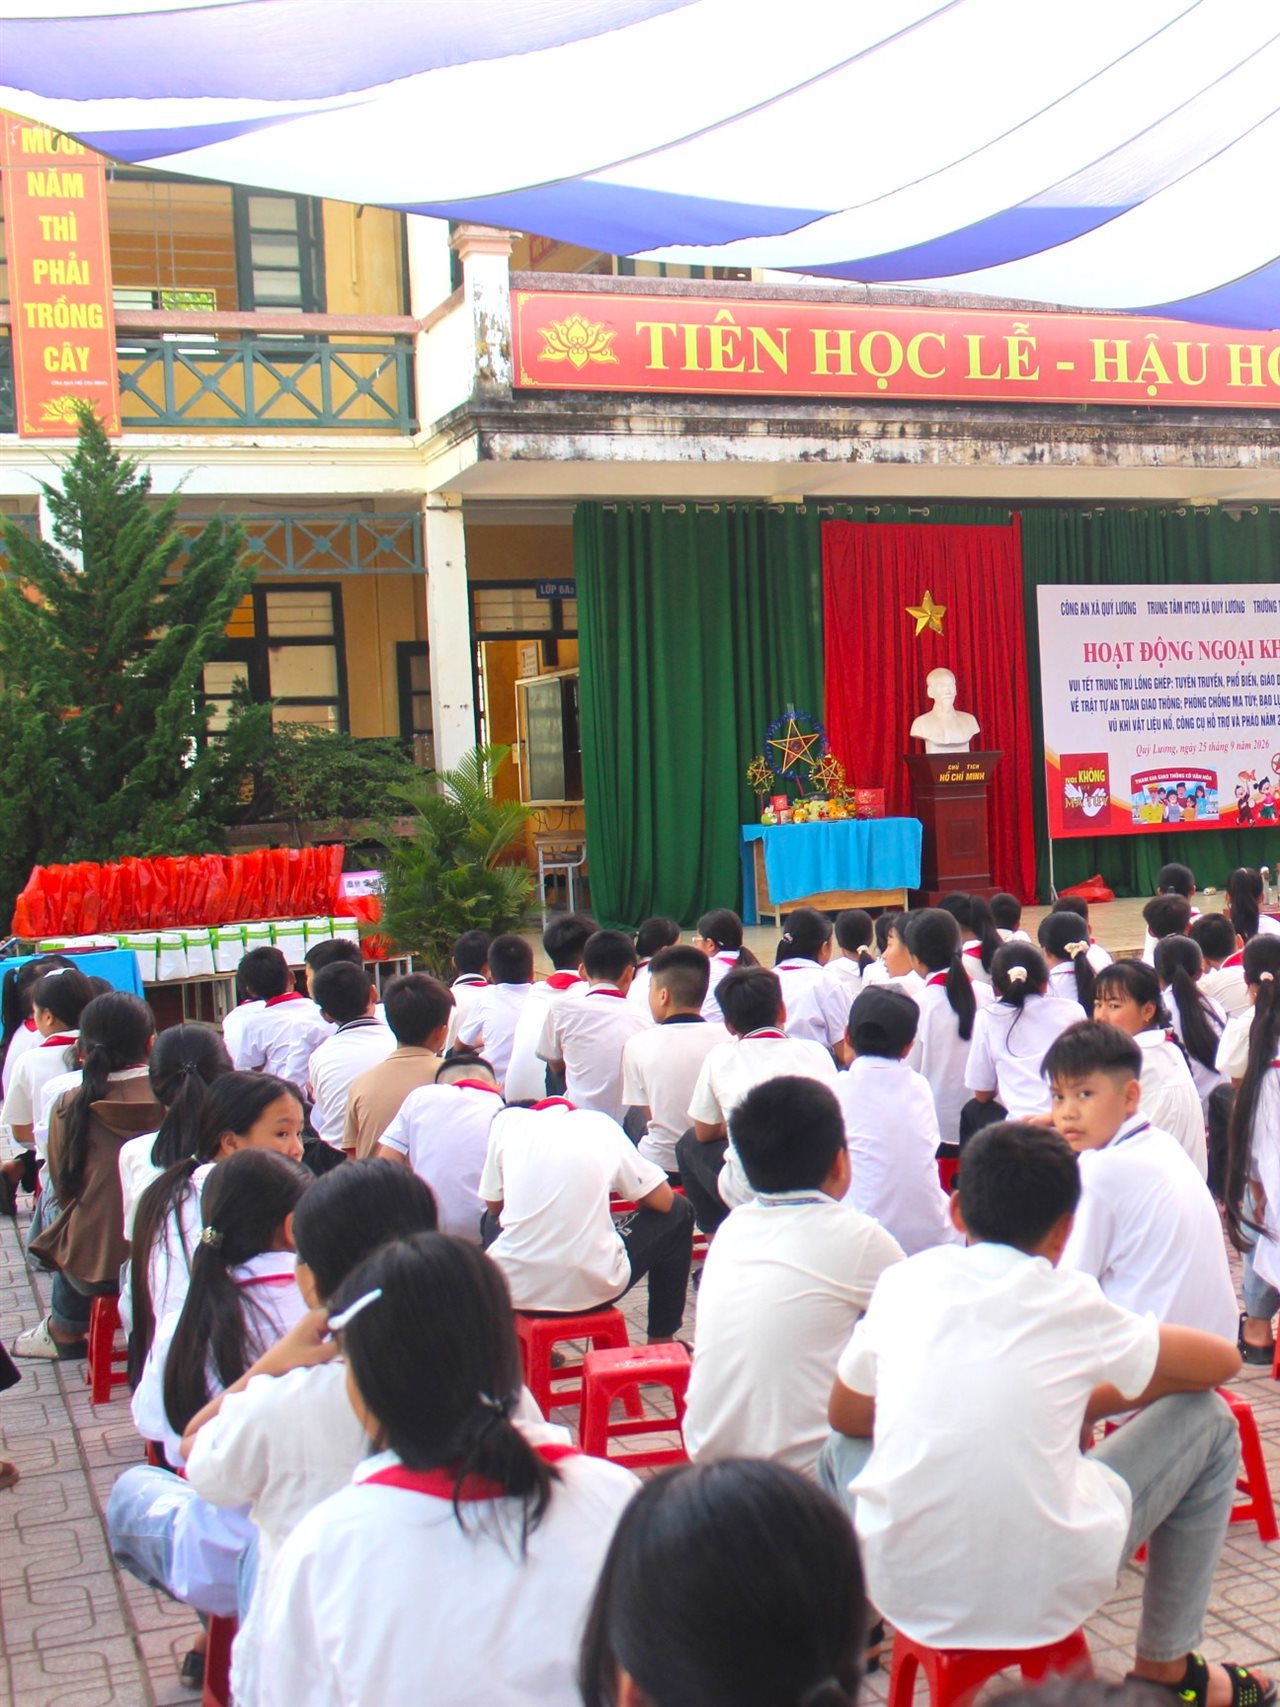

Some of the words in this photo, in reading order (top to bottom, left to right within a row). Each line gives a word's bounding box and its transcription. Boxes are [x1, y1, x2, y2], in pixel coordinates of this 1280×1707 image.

[26, 167, 85, 198] NĂM
[39, 210, 77, 242] THÌ
[32, 251, 90, 285] PHẢI
[24, 294, 104, 329] TRỒNG
[44, 342, 90, 373] CÂY
[635, 309, 792, 375] TIÊN
[809, 327, 947, 390] HỌC
[964, 321, 1040, 381] LỄ
[1056, 361, 1076, 371] -
[1089, 332, 1208, 397] HẬU
[1060, 600, 1079, 616] CÔNG
[1080, 602, 1090, 615] AN
[1091, 600, 1101, 615] XÃ
[1116, 600, 1137, 615] LƯƠNG
[1147, 601, 1168, 615] TRUNG
[1169, 599, 1183, 615] TÂM
[1202, 599, 1211, 614] XÃ
[1225, 599, 1245, 614] LƯƠNG
[1253, 597, 1277, 613] TRƯỜNG
[1083, 642, 1134, 669] HOẠT
[1139, 635, 1193, 669] ĐỘNG
[1198, 639, 1255, 666] NGOẠI
[1068, 679, 1080, 691] VUI
[1082, 675, 1093, 691] TẾT
[1095, 678, 1118, 691] TRUNG
[1120, 678, 1133, 690] THU
[1154, 675, 1174, 690] GHÉP:
[1175, 674, 1196, 688] TUYÊN
[1260, 672, 1275, 686] GIÁO
[1081, 697, 1097, 715] TRẬT
[1100, 698, 1109, 715] TỰ
[1110, 699, 1120, 711] AN
[1121, 696, 1139, 711] TOÀN
[1141, 698, 1157, 710] GIAO
[1158, 695, 1183, 710] THÔNG;
[1184, 694, 1207, 709] PHÒNG
[1208, 692, 1231, 708] CHỐNG
[1232, 695, 1243, 707] MA
[1259, 694, 1272, 708] BẠO
[1108, 717, 1117, 732] VŨ
[1119, 716, 1131, 732] KHÍ
[1132, 716, 1145, 734] VẬT
[1147, 716, 1161, 733] LIỆU
[1176, 715, 1194, 730] CÔNG
[1196, 716, 1205, 732] CỤ
[1207, 712, 1216, 729] HỖ
[1217, 715, 1230, 731] TRỢ
[1232, 713, 1240, 728] VÀ
[1241, 713, 1259, 727] PHÁO
[1261, 712, 1276, 726] NĂM
[1153, 743, 1178, 756] Lương,
[1179, 743, 1196, 755] ngày
[1198, 742, 1207, 752] 25
[1208, 741, 1229, 753] tháng
[1230, 740, 1235, 750] 9
[1236, 741, 1252, 751] năm
[1253, 740, 1270, 750] 2026
[940, 770, 950, 782] HỒ
[951, 771, 965, 781] CHÍ
[966, 771, 985, 781] MINH
[1078, 767, 1106, 783] KHÔNG
